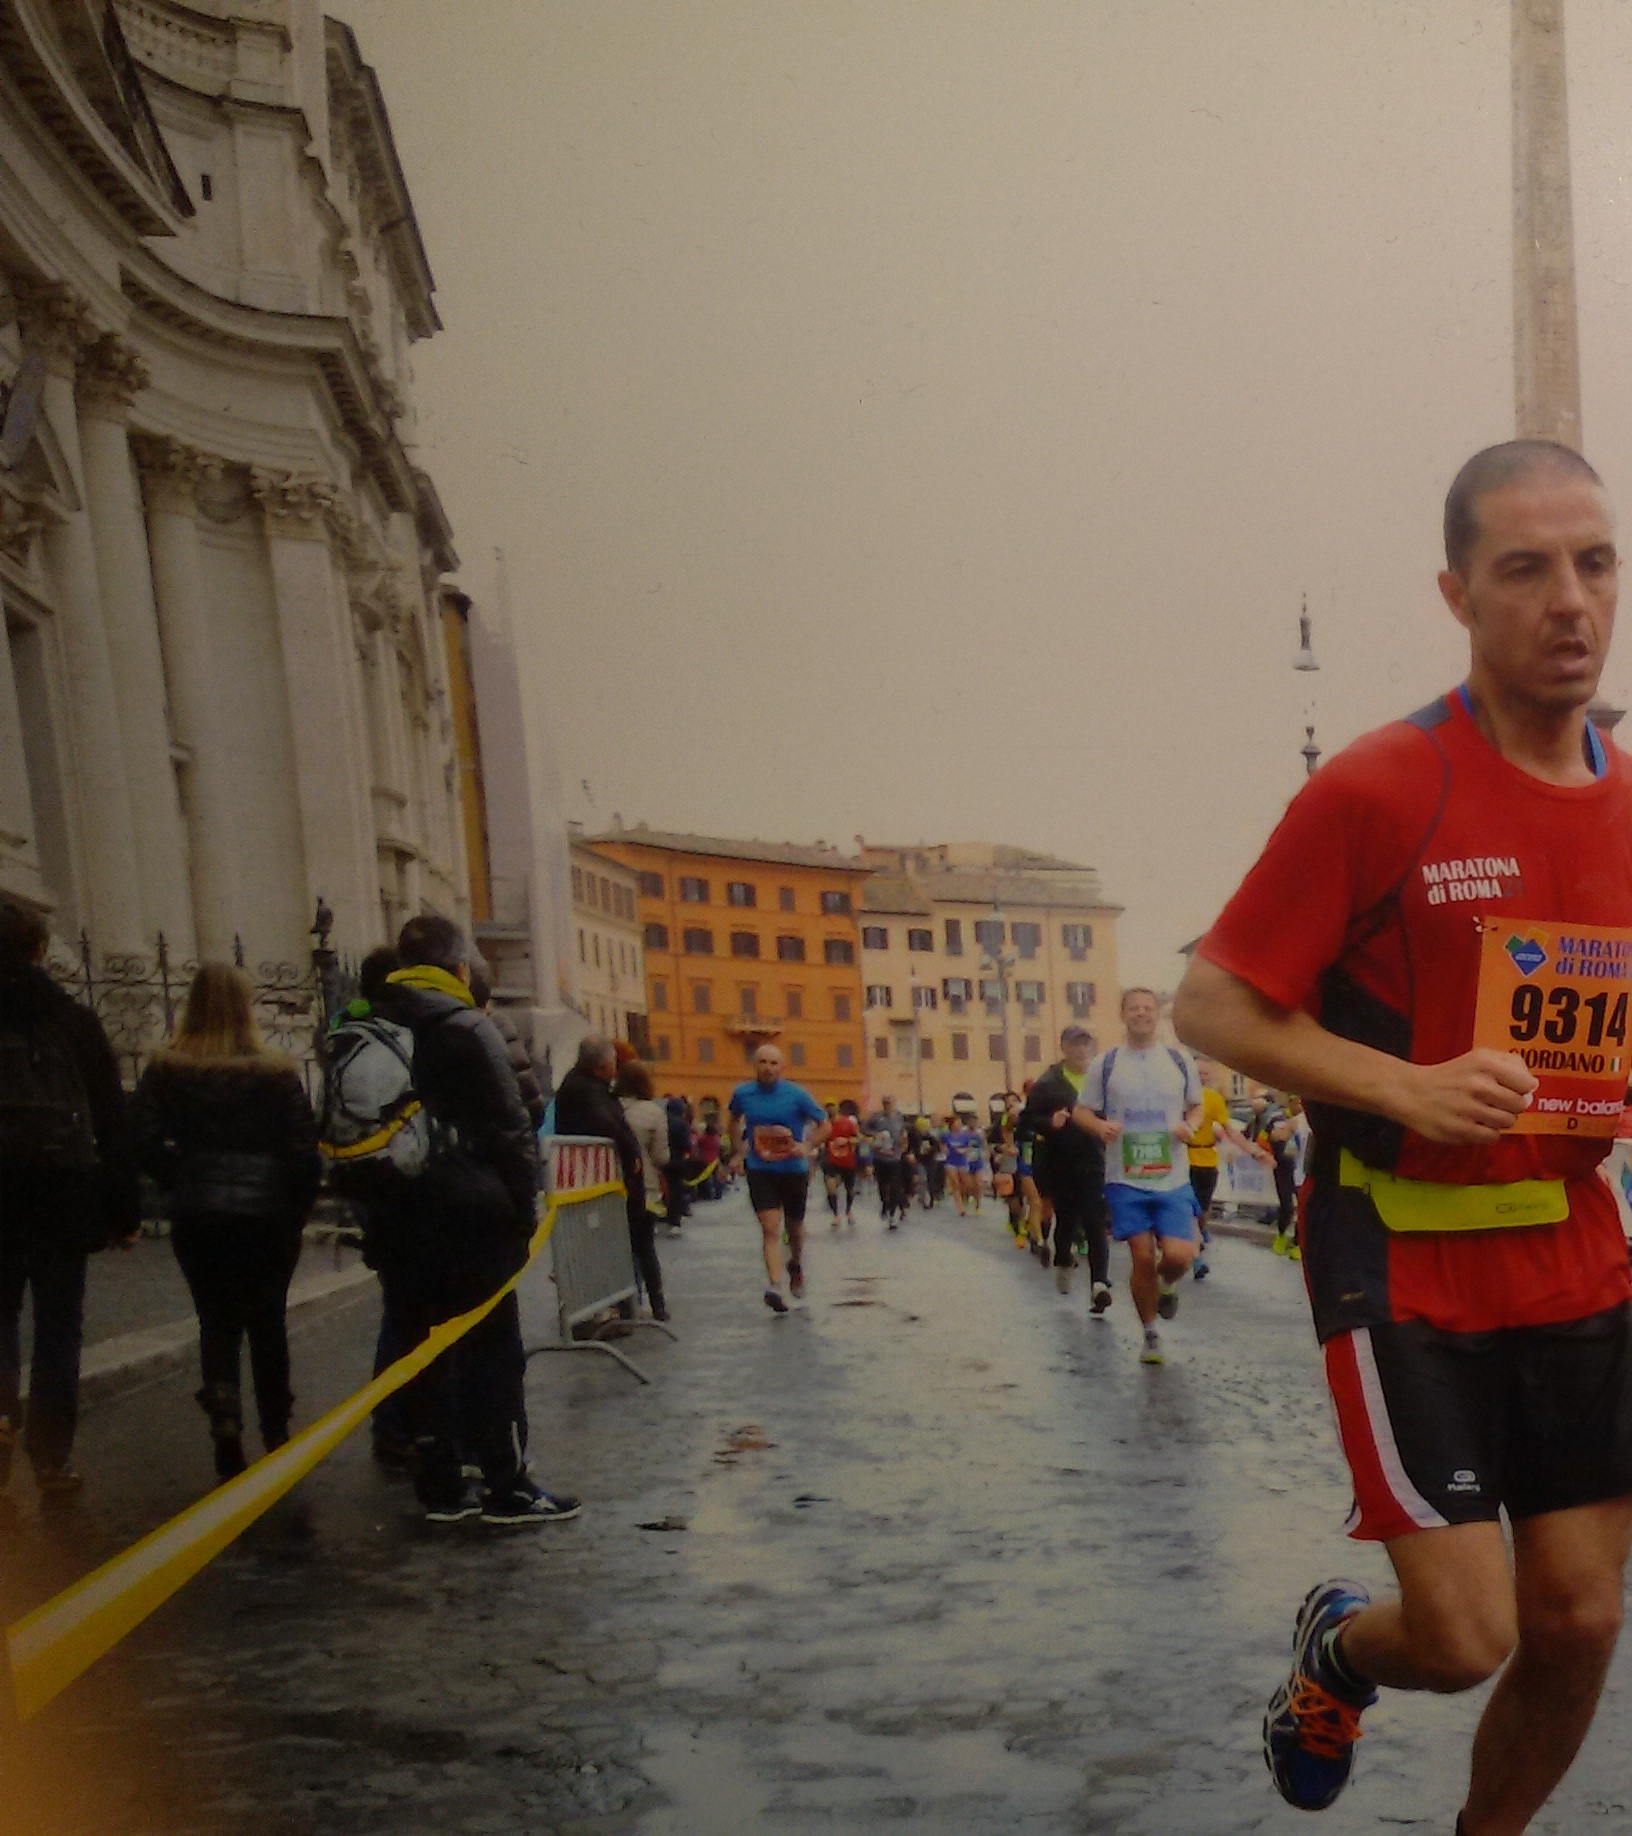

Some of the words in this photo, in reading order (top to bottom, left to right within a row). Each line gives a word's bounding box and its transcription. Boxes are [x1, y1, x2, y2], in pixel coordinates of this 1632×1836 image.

[1422, 857, 1520, 884] MARATONA
[1427, 884, 1447, 905] di
[1449, 879, 1502, 901] ROMA
[1509, 984, 1628, 1047] 9314
[1509, 1048, 1605, 1074] IORDANO
[1537, 1097, 1574, 1112] new
[1567, 1117, 1578, 1130] D
